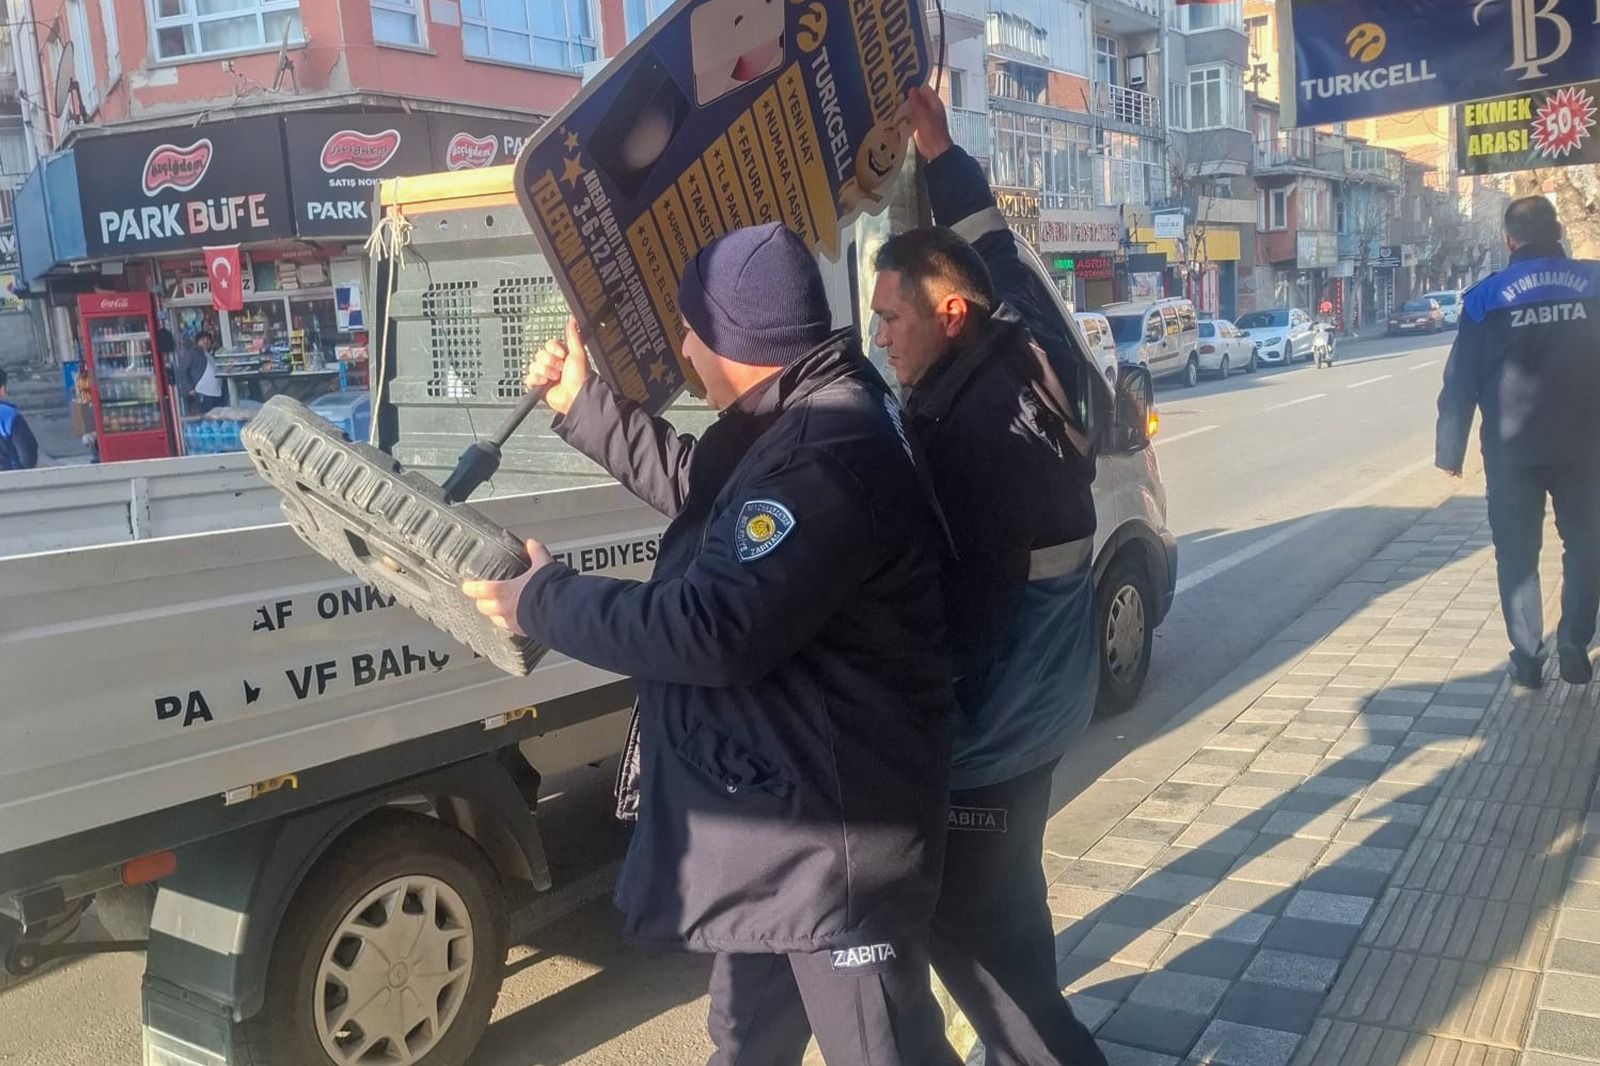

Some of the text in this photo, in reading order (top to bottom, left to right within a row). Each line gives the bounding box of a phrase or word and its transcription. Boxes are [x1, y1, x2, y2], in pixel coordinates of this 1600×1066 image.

[1301, 59, 1436, 100] TURKCELL
[787, 88, 814, 164] YENİ HAT
[811, 46, 852, 181] TURKCELL
[1465, 98, 1532, 126] EKMEK
[764, 107, 791, 184] NUMARA
[1467, 129, 1529, 157] ARASI
[329, 178, 357, 188] SATIŞ
[715, 160, 725, 181] TL
[739, 135, 764, 204] FATURA
[100, 193, 269, 244] PARK BÜFE
[307, 201, 368, 220] PARK
[583, 169, 612, 212] KREDİ
[599, 209, 623, 246] KARTI
[573, 196, 612, 264] 3-6-12
[600, 260, 621, 286] AY
[646, 249, 657, 265] VE
[1510, 302, 1587, 328] ZABITA
[832, 943, 896, 967] ZABITA
